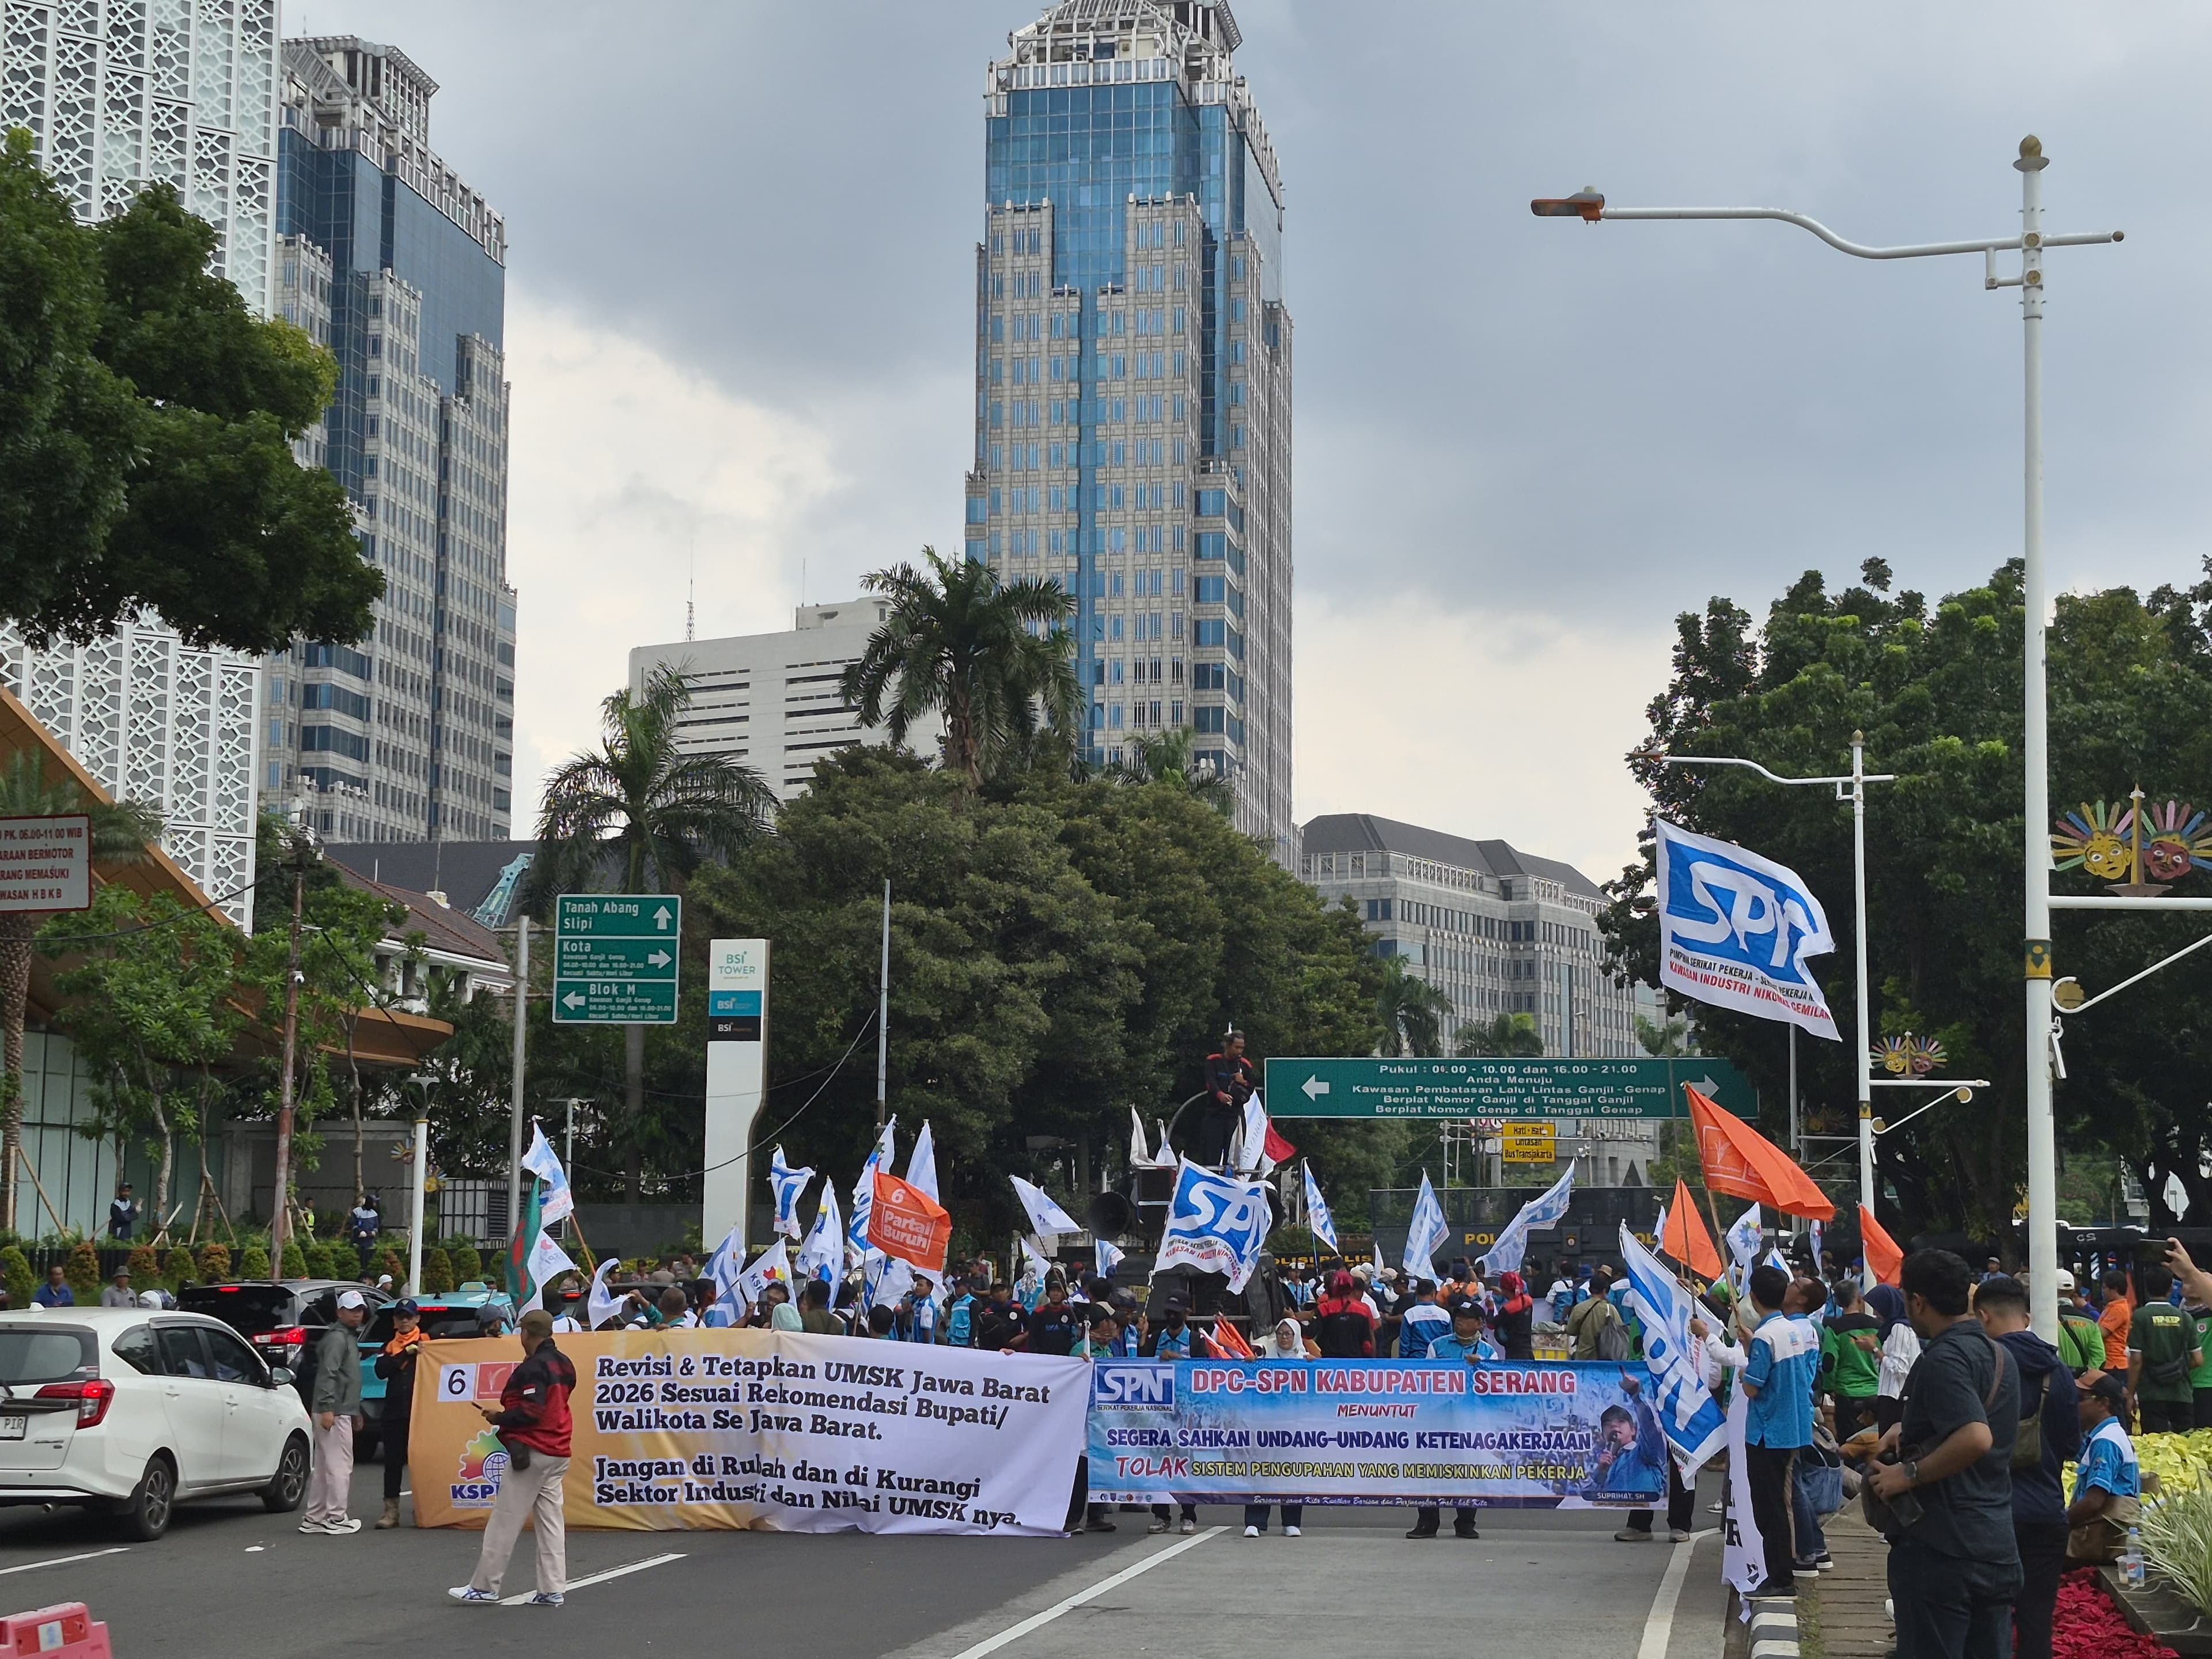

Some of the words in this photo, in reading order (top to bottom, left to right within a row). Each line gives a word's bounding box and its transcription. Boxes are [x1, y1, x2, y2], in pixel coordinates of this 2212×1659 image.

[66, 828, 82, 838] WIB
[28, 848, 74, 860] BERMOTOR
[25, 868, 69, 880] MEMASUKI
[565, 902, 597, 913] Tanah
[603, 901, 639, 916] Abang
[564, 916, 592, 931] Slipi
[563, 941, 591, 952] Kota
[726, 953, 744, 964] BSI
[719, 966, 756, 974] TOWER
[1718, 964, 1753, 981] PEKERJA
[589, 983, 619, 995] Blok
[627, 984, 636, 995] M
[1700, 973, 1751, 995] INDUSTRI
[717, 1000, 733, 1010] BSI
[718, 1024, 732, 1032] BSI
[1380, 1065, 1418, 1073] Pukul
[1481, 1066, 1515, 1074] 10.00
[1522, 1065, 1548, 1074] dan
[1554, 1065, 1588, 1074] 16.00
[1601, 1065, 1637, 1074] 21.00
[1466, 1075, 1500, 1084] Anda
[1507, 1076, 1552, 1085] Menuju
[1353, 1085, 1410, 1093] Kawasan
[1532, 1086, 1571, 1094] Lintas
[1578, 1086, 1613, 1094] Ganjil
[1624, 1086, 1665, 1094] Genap
[1384, 1096, 1429, 1104] Berplat
[1434, 1096, 1476, 1104] Nomor
[1482, 1096, 1516, 1104] Ganjil
[1541, 1096, 1592, 1105] Tanggal
[1597, 1096, 1634, 1104] Ganjil
[1376, 1105, 1422, 1114] Berplat
[1427, 1105, 1469, 1113] Nomor
[1477, 1105, 1518, 1114] Genap
[1524, 1106, 1536, 1114] di
[1542, 1106, 1594, 1115] Tanggal
[1600, 1106, 1643, 1115] Genap
[1513, 1126, 1527, 1135] Hati
[1505, 1149, 1516, 1158] Bus
[891, 1188, 906, 1204] 6
[884, 1210, 931, 1236] Partai
[448, 1369, 465, 1395] 6
[597, 1355, 672, 1377] Revisi
[680, 1357, 695, 1376] &
[703, 1356, 816, 1381] Tetapkan
[825, 1362, 904, 1388] UMSK
[911, 1371, 974, 1395] Jawa
[982, 1377, 1050, 1404] Barat
[1096, 1368, 1173, 1402] SPN
[1192, 1369, 1306, 1392] DPC-SPN
[1317, 1370, 1464, 1393] KABUPATEN
[1474, 1371, 1576, 1394] SERANG
[597, 1384, 654, 1404] 2026
[661, 1382, 740, 1403] Sesuai
[748, 1383, 908, 1415] Rekomendasi
[915, 1397, 1009, 1430] Bupati/
[1338, 1404, 1418, 1418] MENUNTUT
[5, 1418, 23, 1429] PIR
[596, 1408, 706, 1431] Walikota
[713, 1410, 743, 1429] Se
[750, 1410, 802, 1434] Jawa
[809, 1414, 882, 1440] Barat.
[1107, 1429, 1172, 1447] SEGERA
[1178, 1429, 1250, 1448] SAHKAN
[1257, 1430, 1409, 1449] UNDANG-UNDANG
[1416, 1431, 1591, 1450] KETENAGAKERJAAN
[1116, 1457, 1190, 1479] TOLAK
[1192, 1462, 1247, 1476] SISTEM
[1251, 1463, 1354, 1478] PENGUPAHAN
[1358, 1464, 1399, 1478] YANG
[1403, 1464, 1512, 1479] MEMISKINKAN
[1516, 1465, 1586, 1480] PEKERJA
[597, 1457, 685, 1482] Jangan
[692, 1455, 714, 1475] di
[792, 1460, 838, 1484] dan
[844, 1465, 869, 1487] di
[876, 1469, 981, 1501] Kurangi
[597, 1482, 679, 1503] Sektor
[770, 1484, 815, 1508] dan
[821, 1490, 881, 1513] Nilai
[888, 1497, 969, 1522] UMSK
[972, 1508, 1022, 1530] nya.
